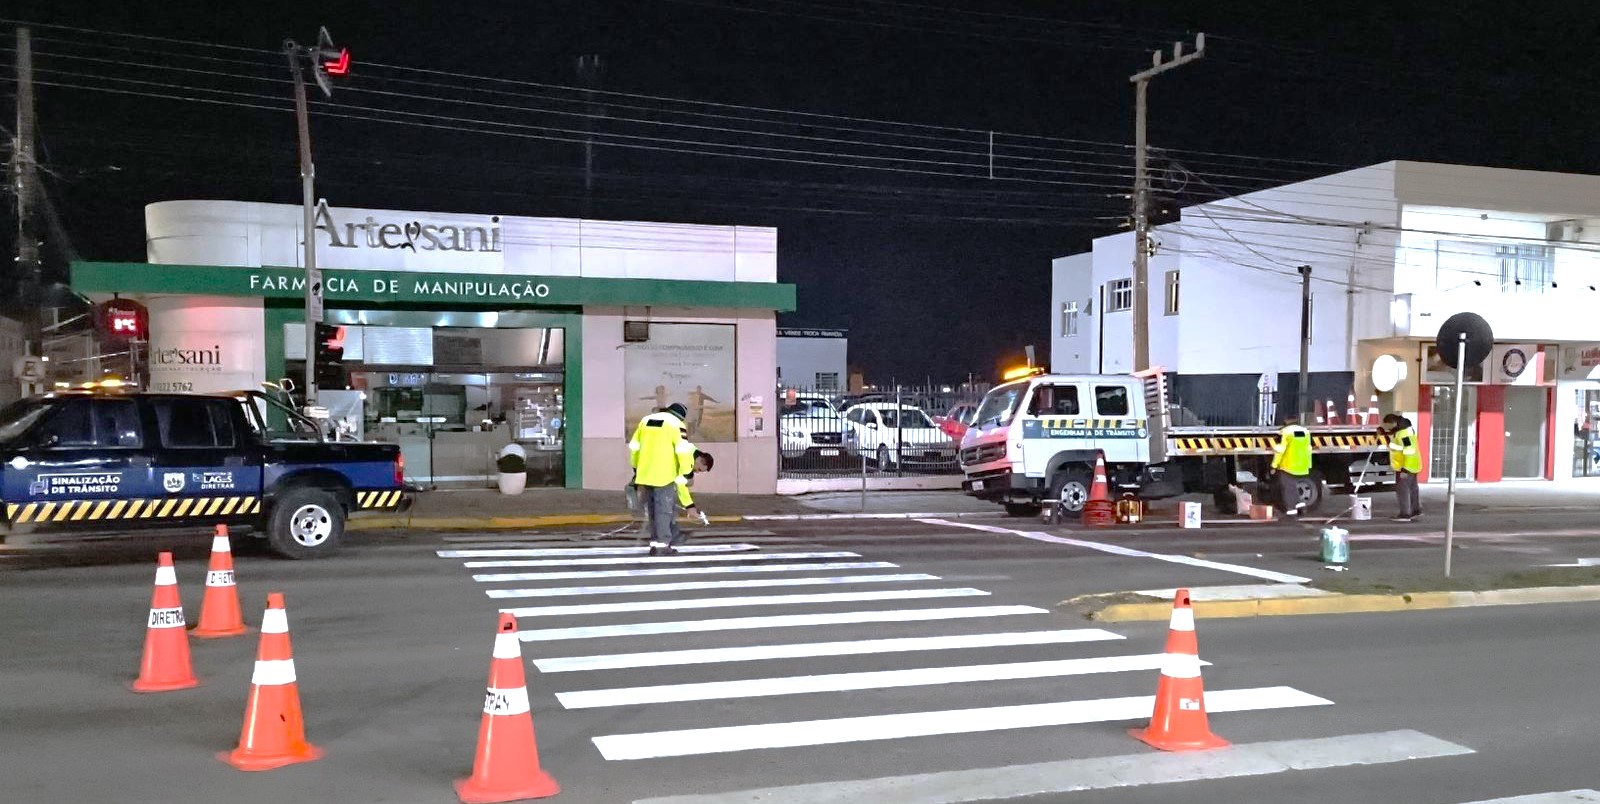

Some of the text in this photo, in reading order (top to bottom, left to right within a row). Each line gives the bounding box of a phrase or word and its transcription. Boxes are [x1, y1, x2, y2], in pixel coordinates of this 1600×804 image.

[250, 275, 550, 299] FARMCIA DE MANIPULAÇÃO
[172, 382, 193, 391] 5762
[51, 475, 120, 485] SINALIZAÇÃO
[51, 485, 118, 494] DE TRÂNSITO
